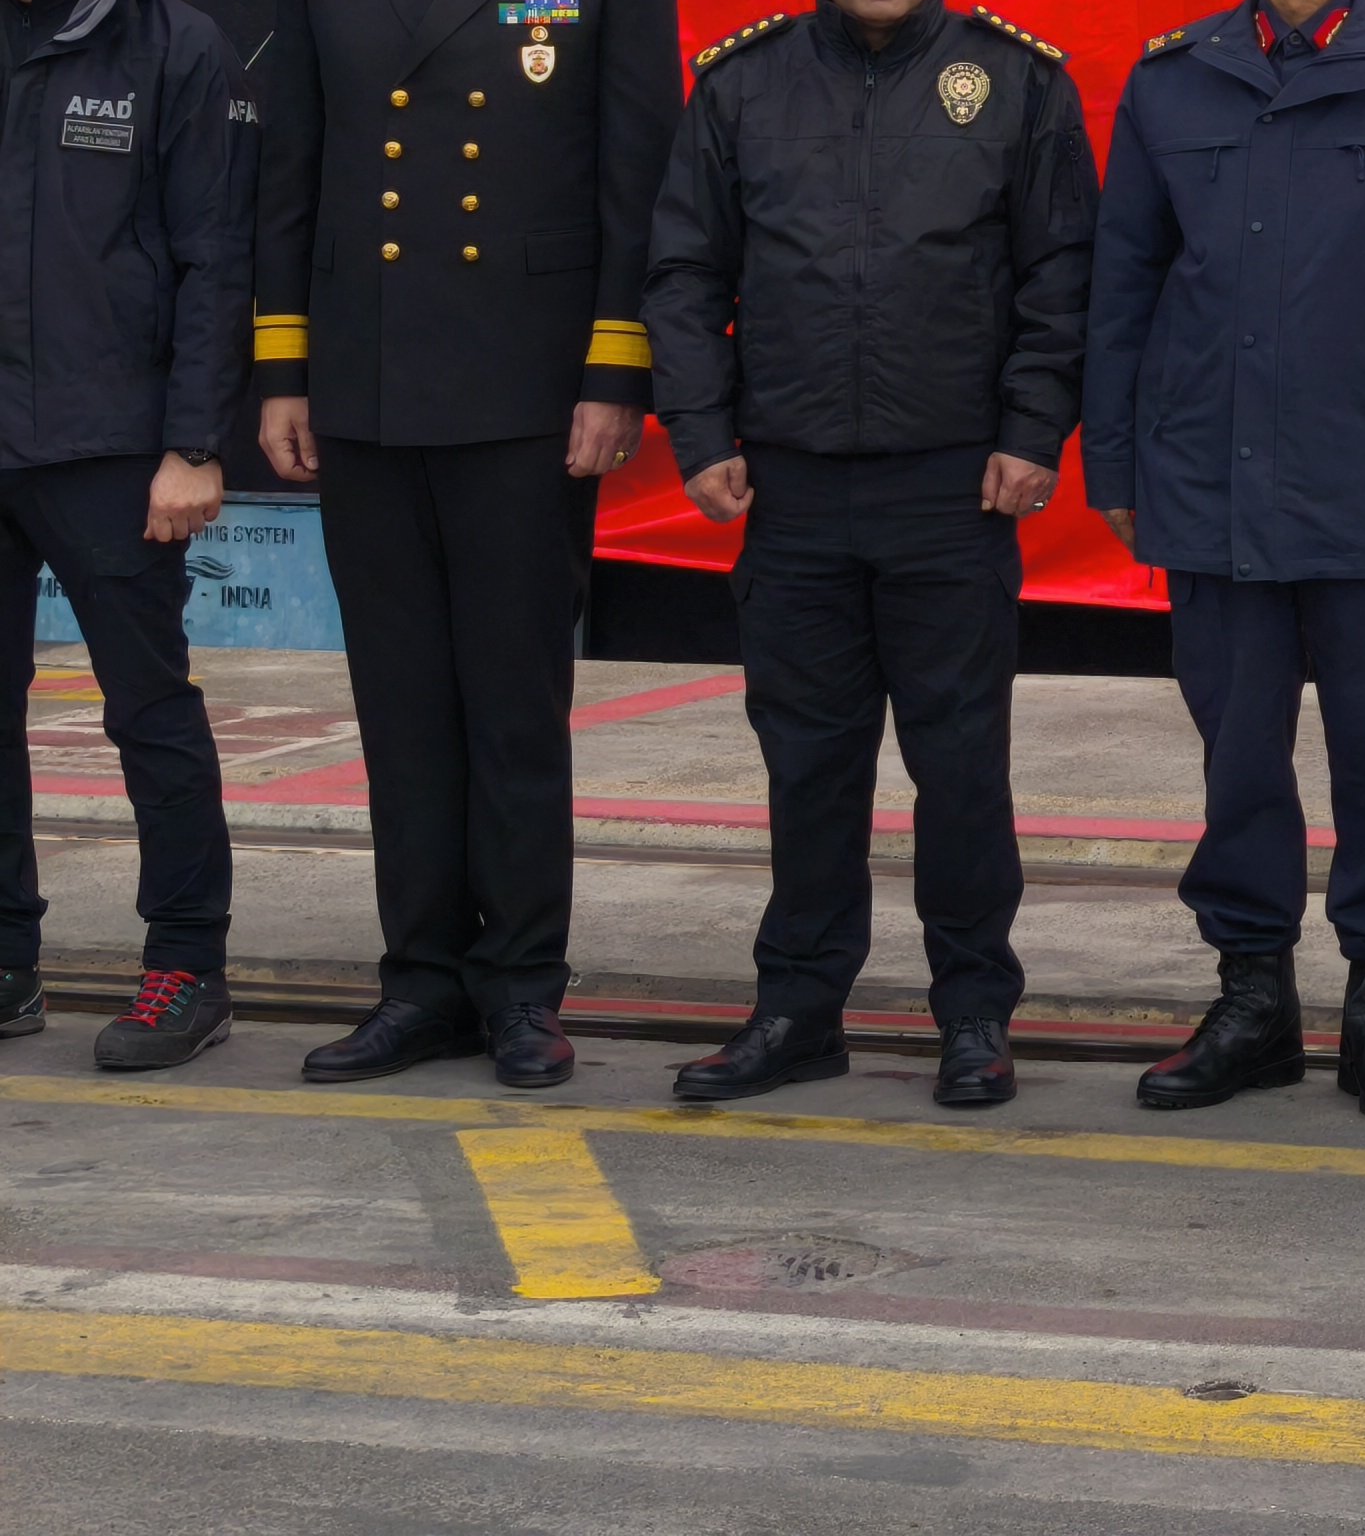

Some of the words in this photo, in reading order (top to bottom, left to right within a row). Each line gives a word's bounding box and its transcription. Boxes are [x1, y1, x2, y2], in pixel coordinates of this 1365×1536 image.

[65, 94, 133, 119] AFAD
[233, 525, 295, 544] SYSTEM
[221, 584, 272, 610] INDIA
